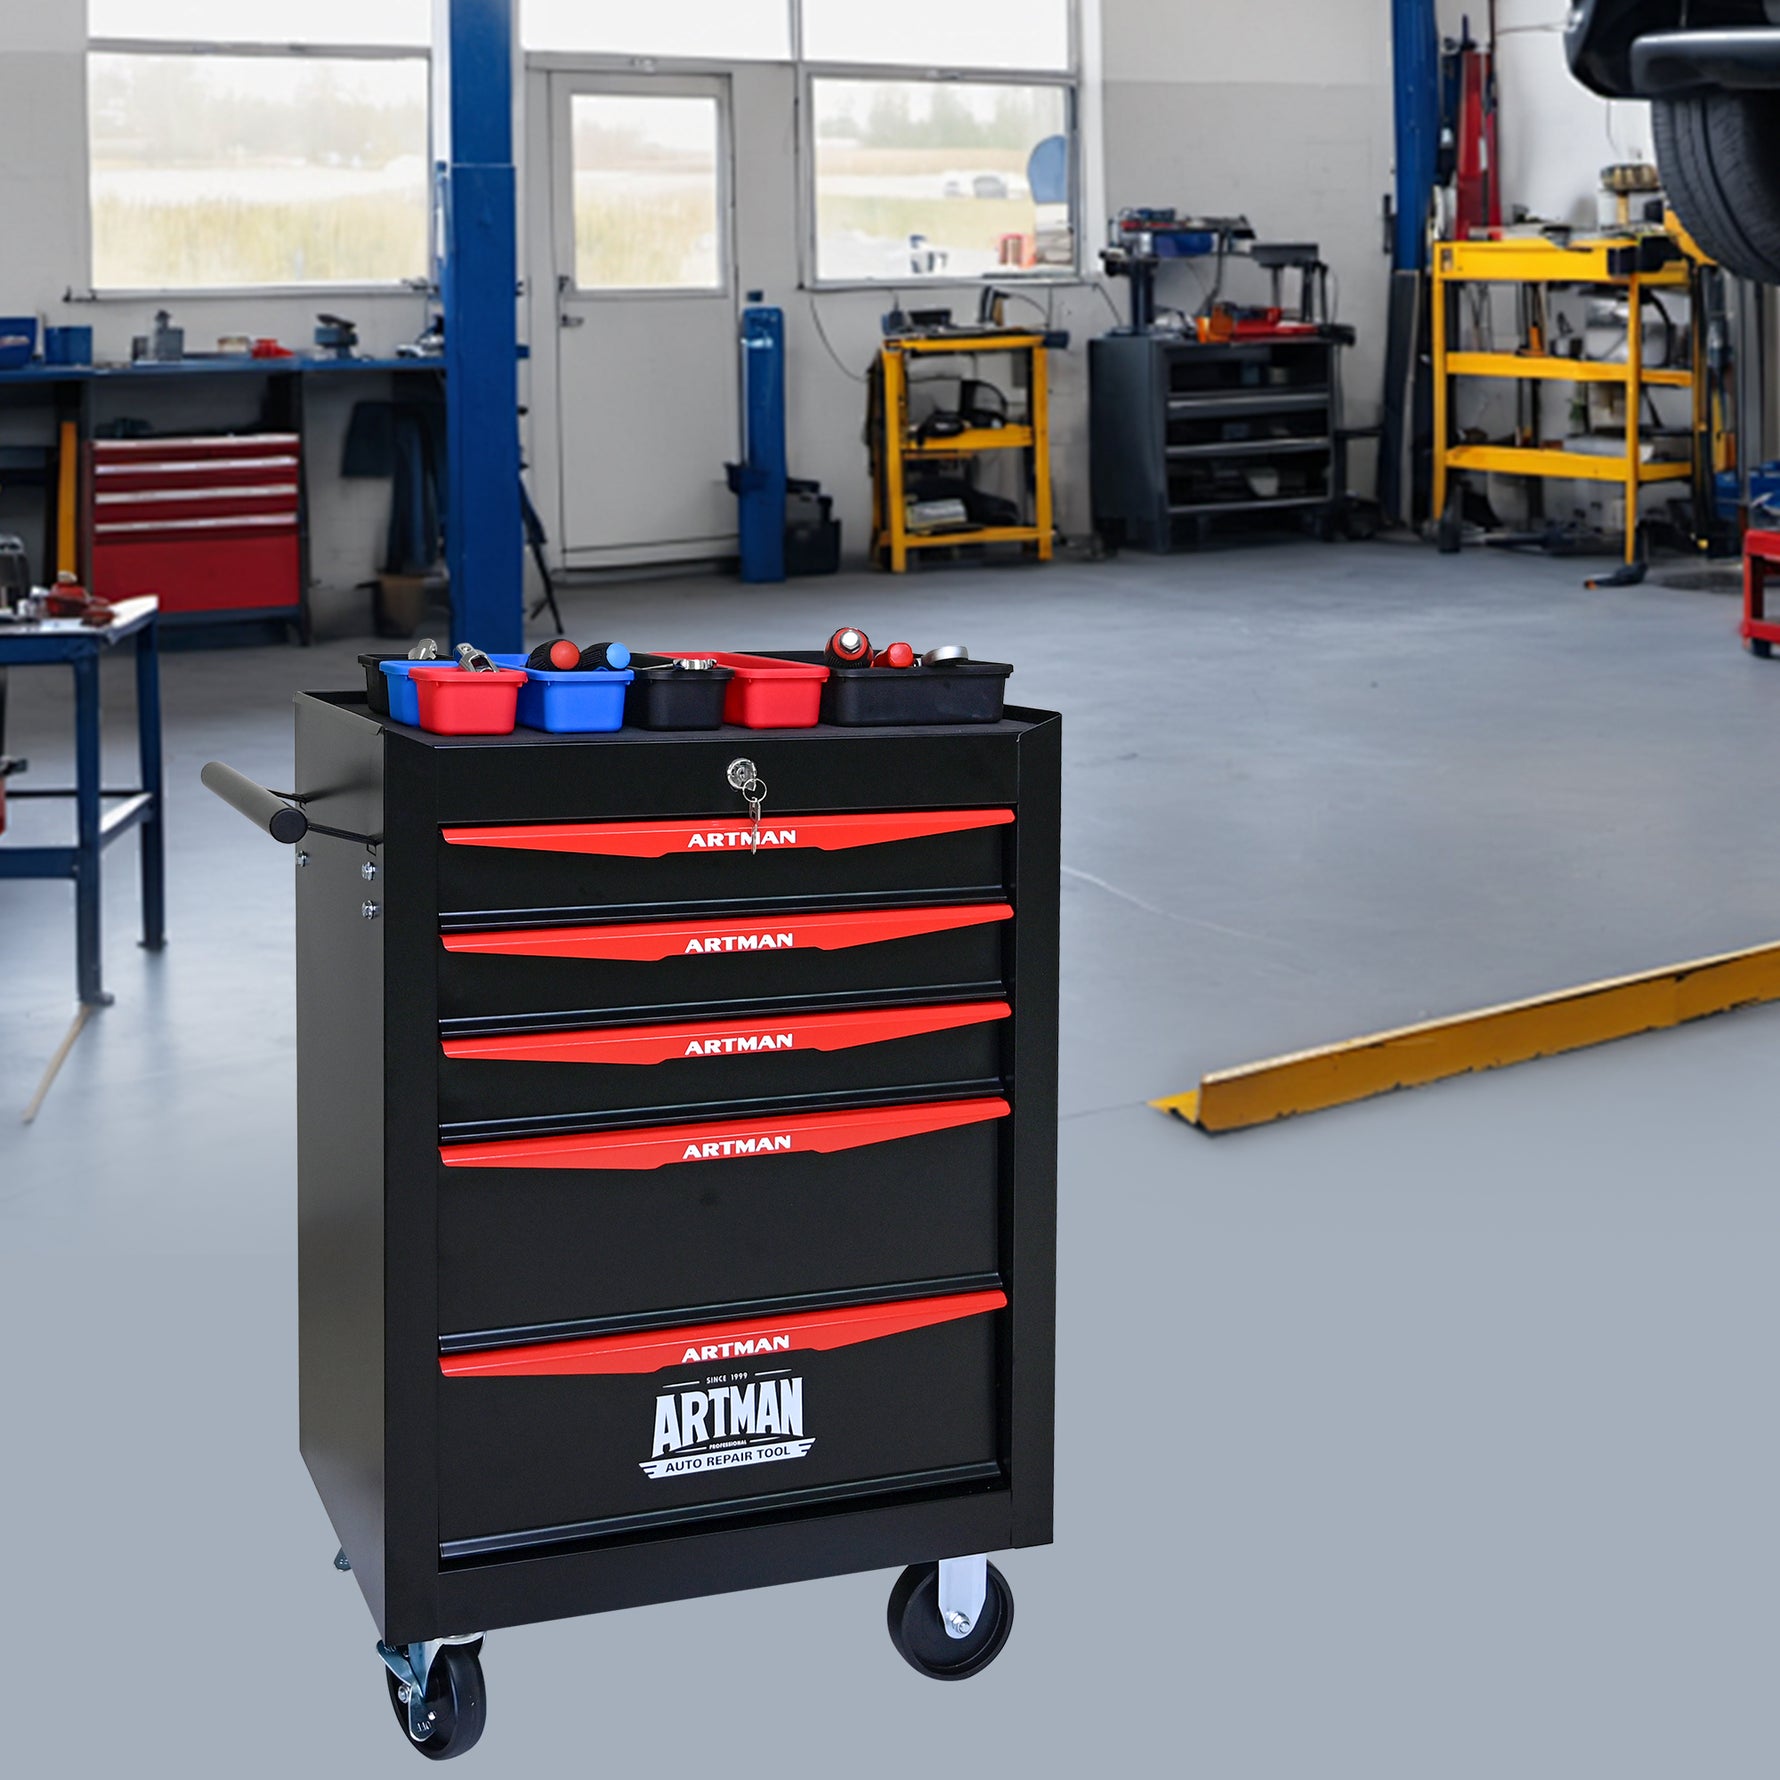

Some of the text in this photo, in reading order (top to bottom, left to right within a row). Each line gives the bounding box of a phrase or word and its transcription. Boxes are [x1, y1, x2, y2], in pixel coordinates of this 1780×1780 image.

[687, 830, 796, 848] ARTMAN
[684, 933, 793, 953] ARTMAN
[684, 1033, 793, 1055] ARTMAN
[682, 1135, 791, 1160] ARTMAN
[681, 1335, 790, 1363] ARTMAN
[706, 1372, 748, 1384] SINCE 1999
[651, 1377, 804, 1458] ARTMAN
[665, 1446, 791, 1472] AUTO REPAIR TOOL
